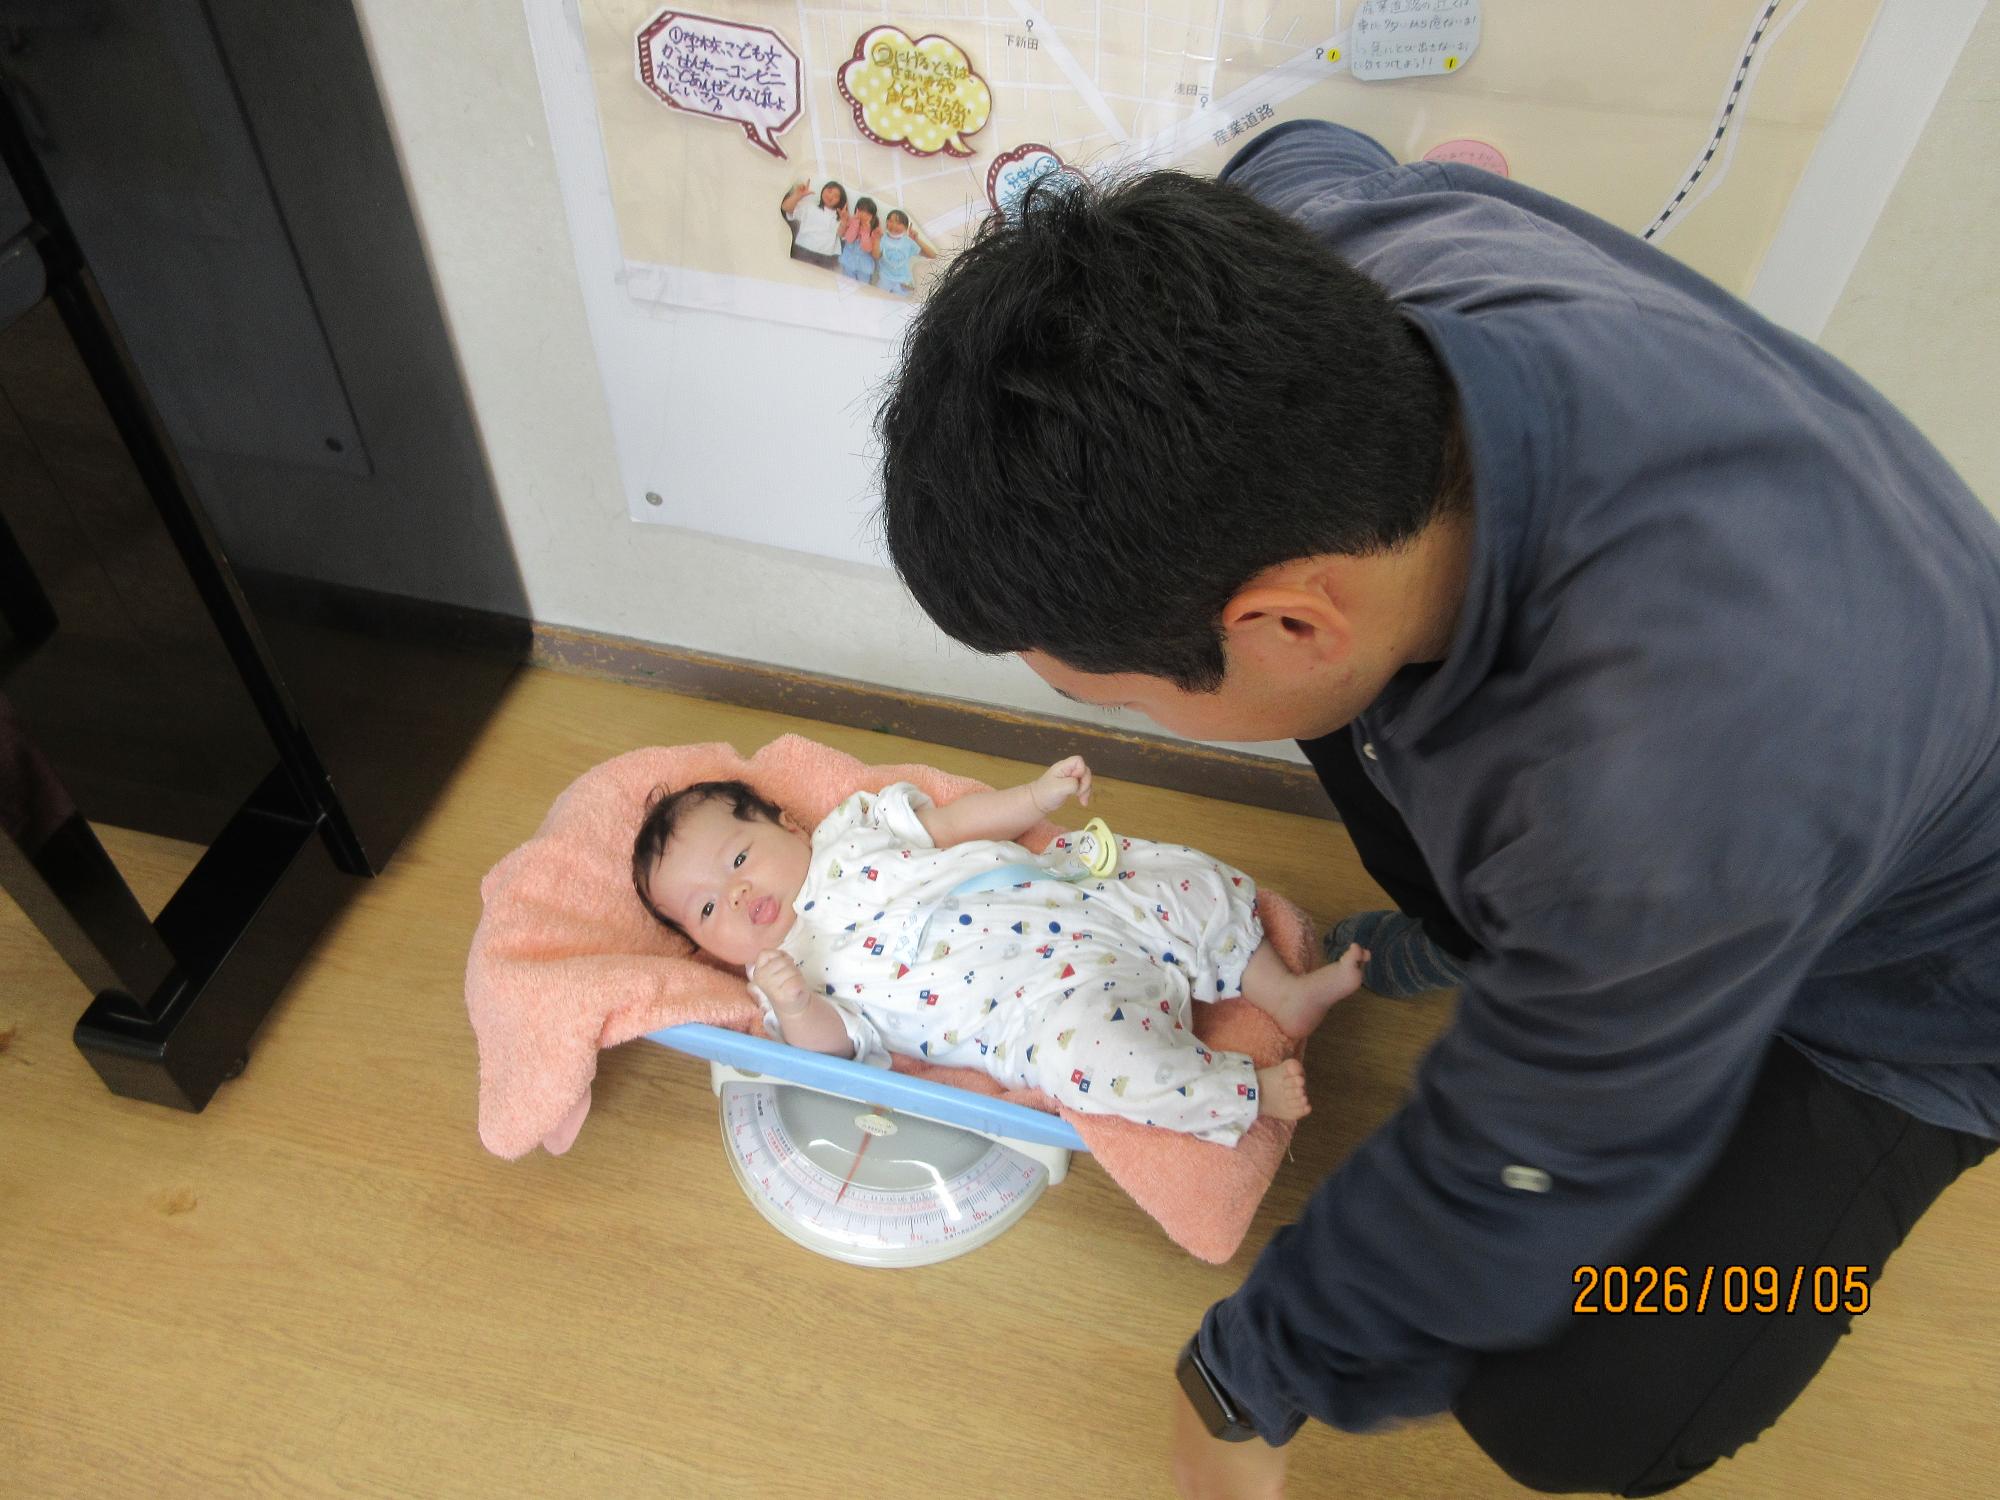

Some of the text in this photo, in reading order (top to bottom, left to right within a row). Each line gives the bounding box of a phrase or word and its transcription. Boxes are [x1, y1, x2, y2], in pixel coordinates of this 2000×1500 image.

[1005, 34, 1038, 51] 下新田
[1212, 103, 1275, 146] 産業道路
